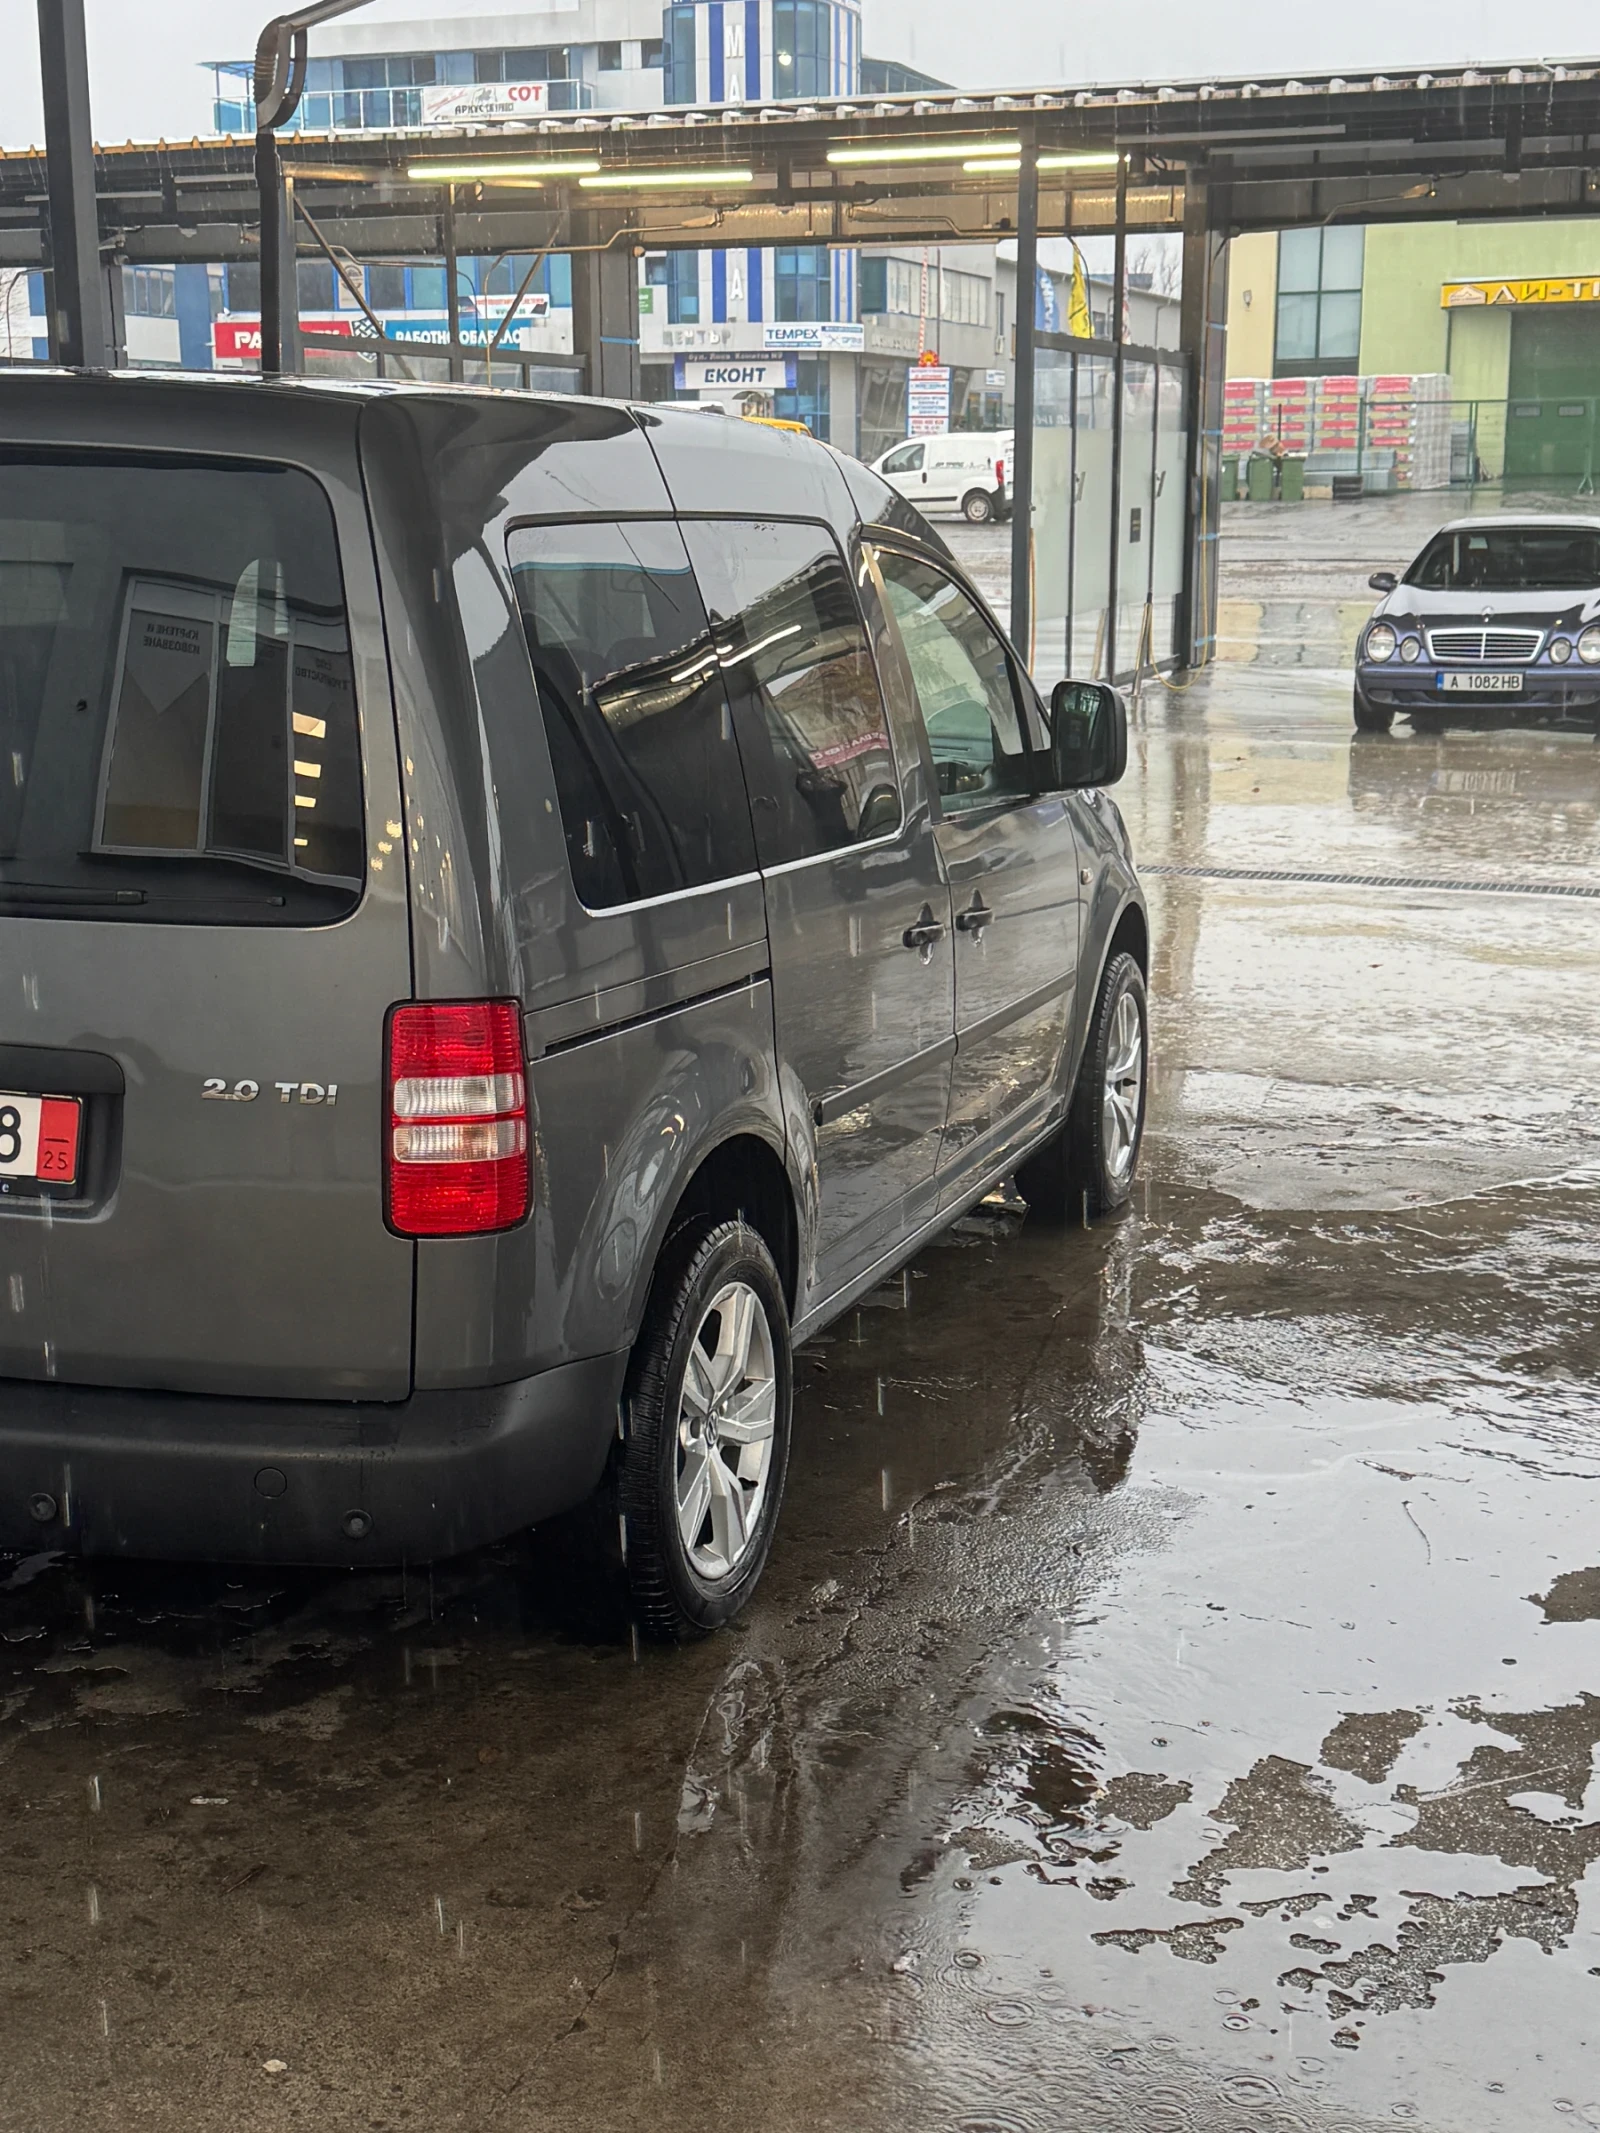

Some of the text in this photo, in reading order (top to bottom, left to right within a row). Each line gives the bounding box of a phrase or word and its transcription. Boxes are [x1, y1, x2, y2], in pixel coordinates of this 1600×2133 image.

[508, 86, 542, 101] СОТ
[1489, 281, 1600, 305] ДИ-Т
[459, 330, 520, 345] ОБЛЕЛО
[663, 330, 731, 347] ЦЕНТЪР
[766, 328, 819, 340] TEMPEX
[704, 367, 767, 383] ЕКОНТ
[201, 1078, 338, 1106] 2.0 TDI
[43, 1150, 68, 1171] 25
